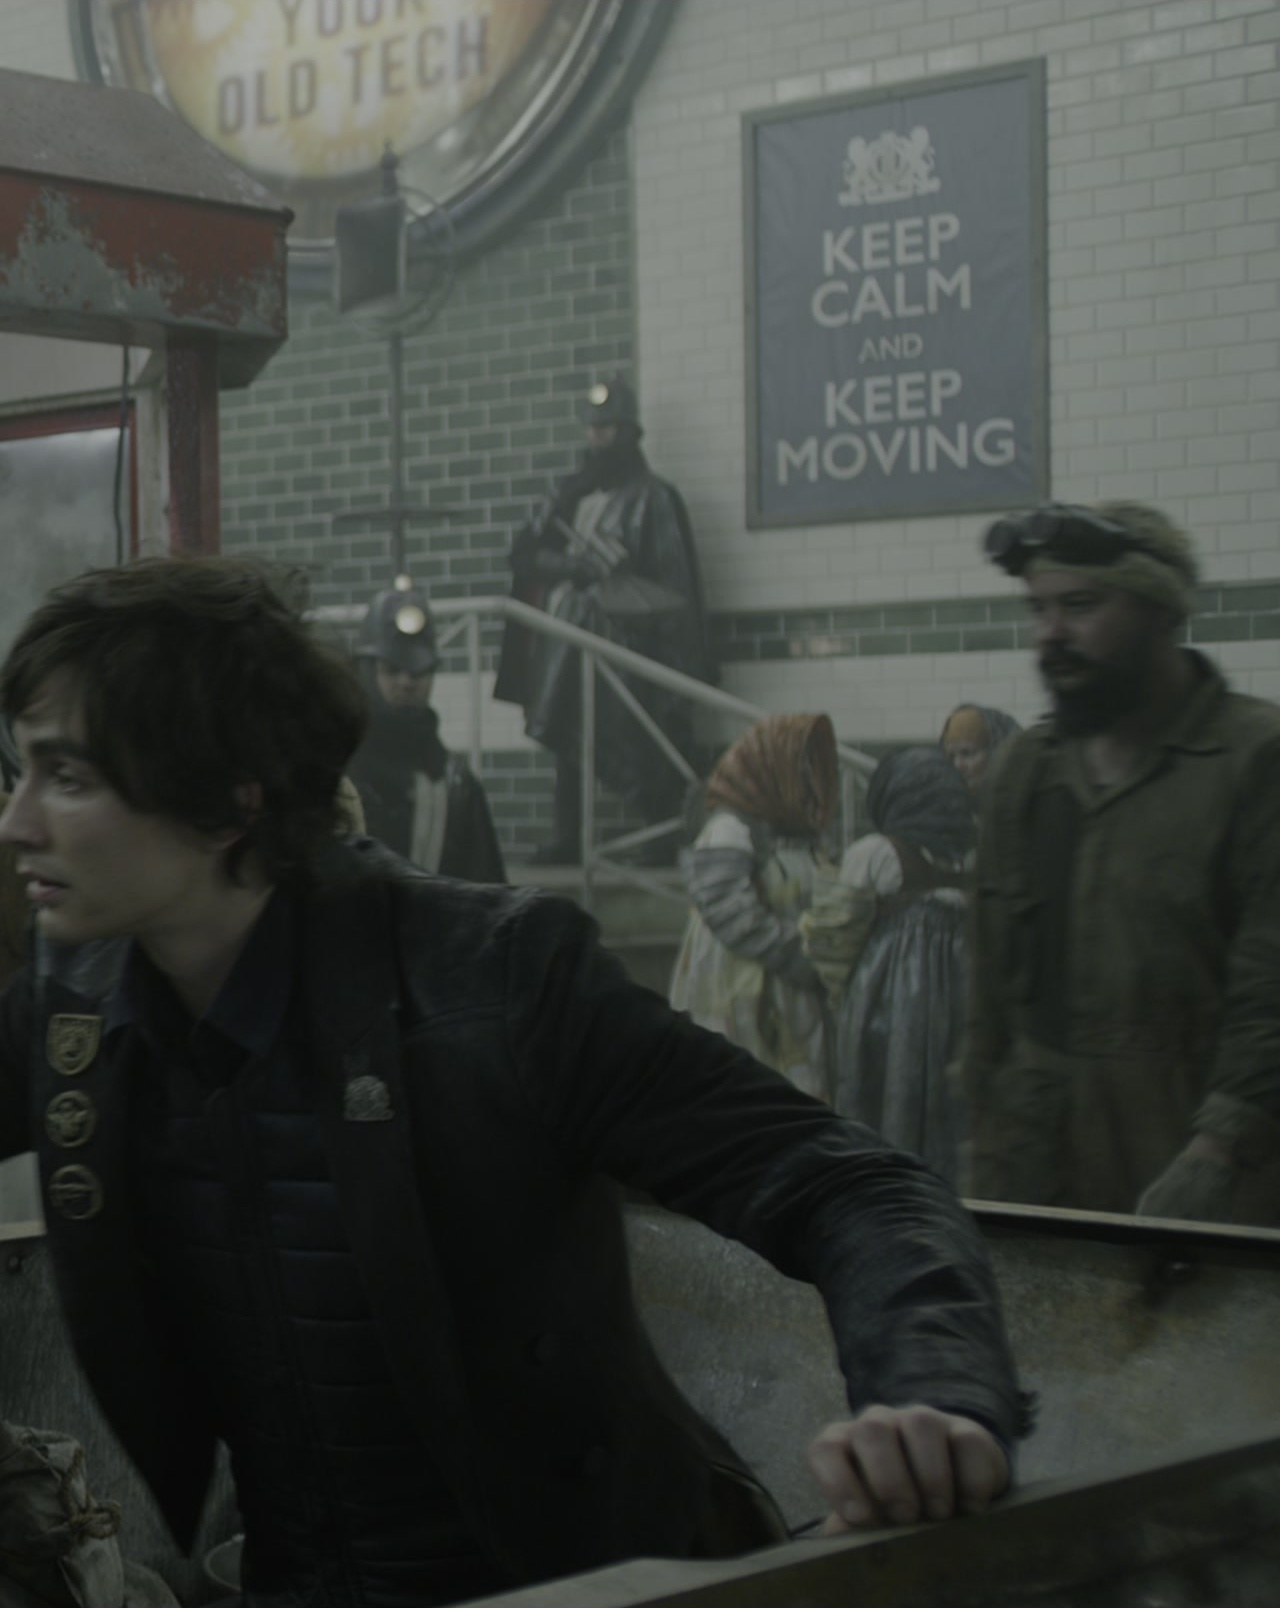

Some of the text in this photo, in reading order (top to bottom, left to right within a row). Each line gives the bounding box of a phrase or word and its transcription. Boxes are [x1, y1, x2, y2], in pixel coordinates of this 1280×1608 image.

[279, 0, 425, 46] YOU
[218, 15, 489, 136] OLD TECH
[823, 213, 959, 276] KEEP
[811, 263, 972, 328] CALM
[859, 333, 924, 363] AND
[825, 370, 962, 429] KEEP
[777, 418, 1015, 486] MOVING
